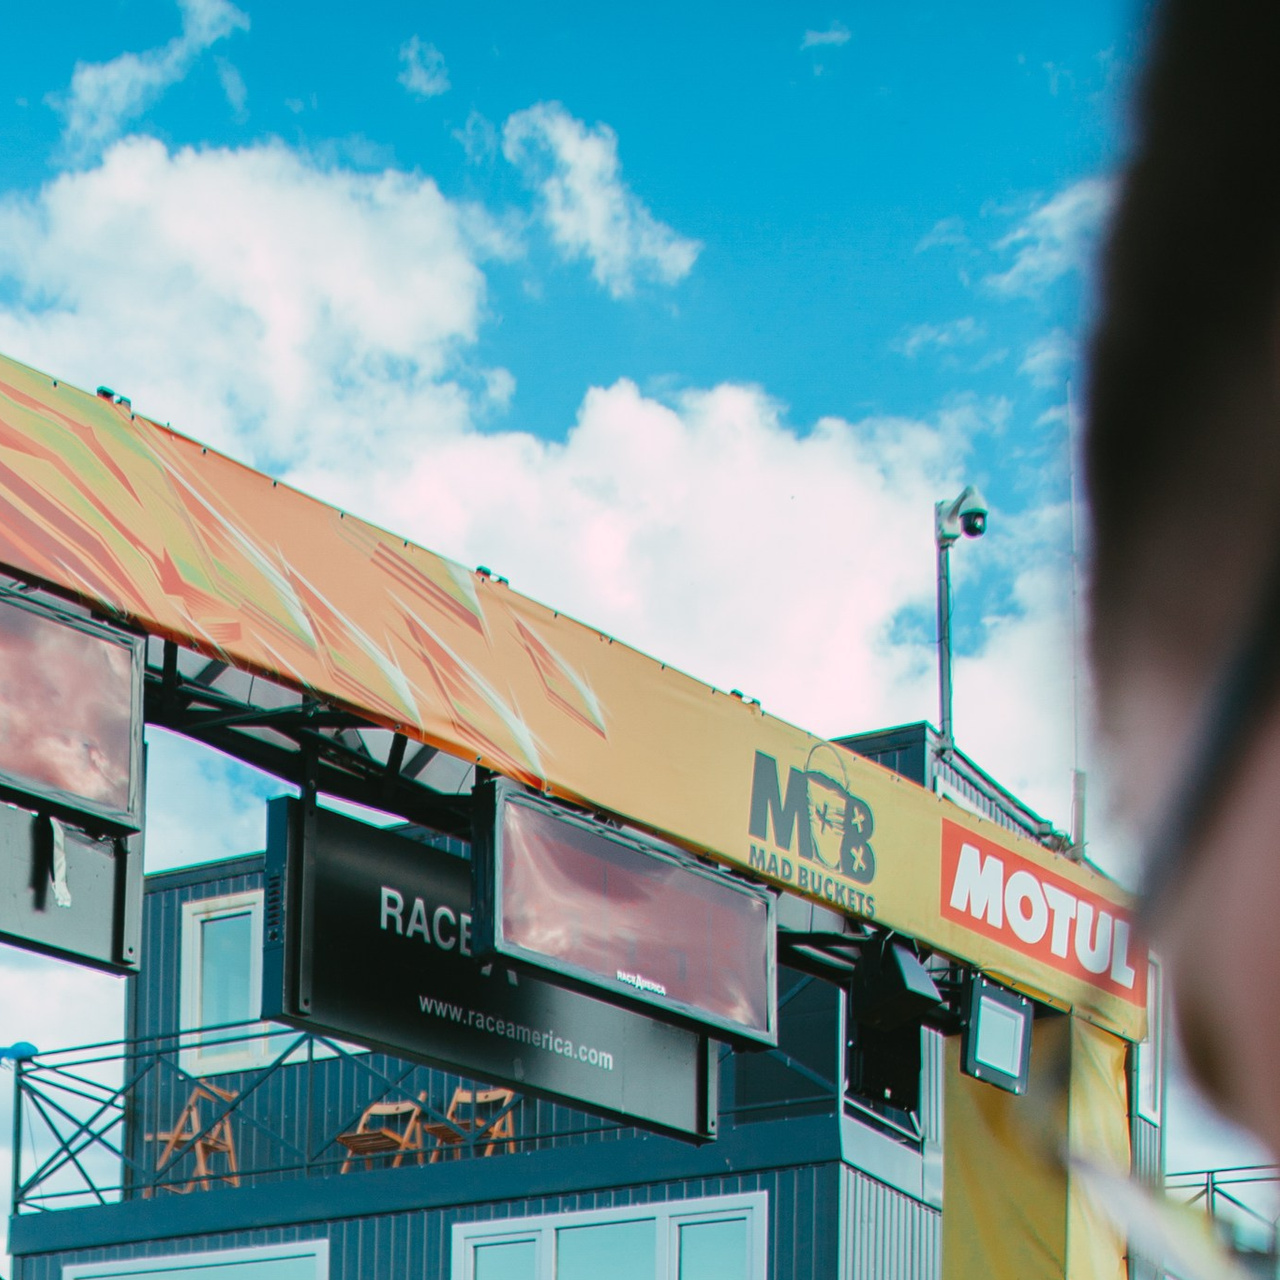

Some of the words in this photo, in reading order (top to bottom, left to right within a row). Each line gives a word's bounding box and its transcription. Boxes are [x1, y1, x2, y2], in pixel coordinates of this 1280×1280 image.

[748, 845, 793, 883] MAD
[797, 863, 876, 919] BUCKETS
[949, 843, 1136, 990] MOTUL
[419, 995, 615, 1071] www.raceamerica.com
